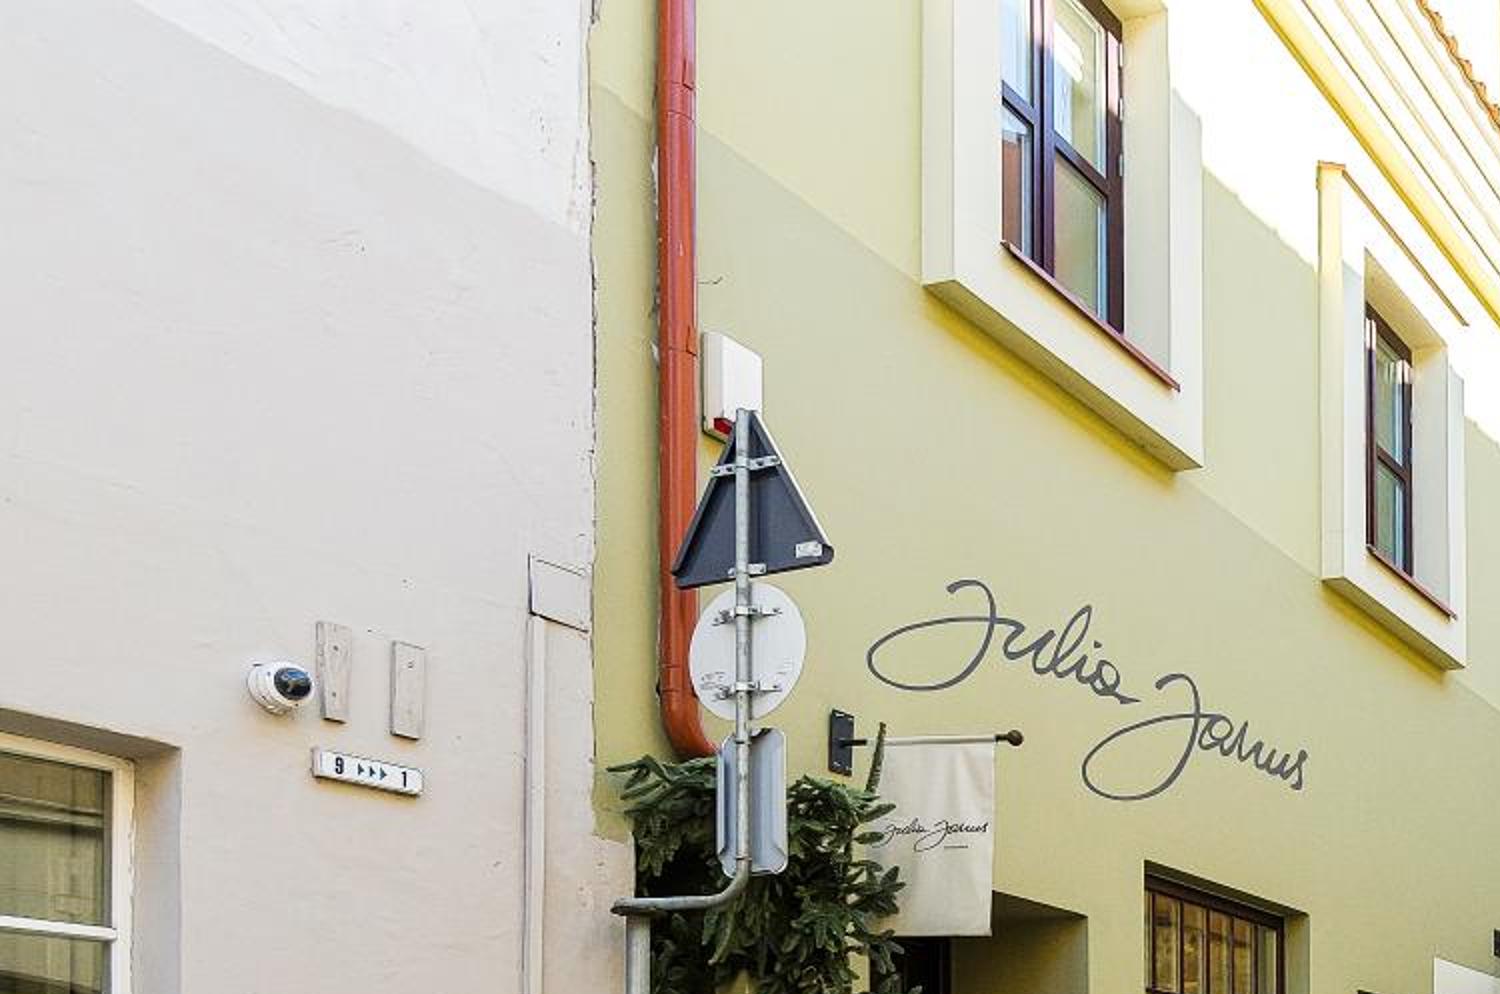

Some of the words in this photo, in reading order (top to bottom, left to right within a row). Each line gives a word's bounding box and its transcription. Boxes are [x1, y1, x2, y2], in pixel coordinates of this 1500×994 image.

[867, 580, 1140, 704] Julia
[1081, 674, 1308, 801] Janus
[335, 756, 345, 775] 9
[401, 771, 408, 788] 1
